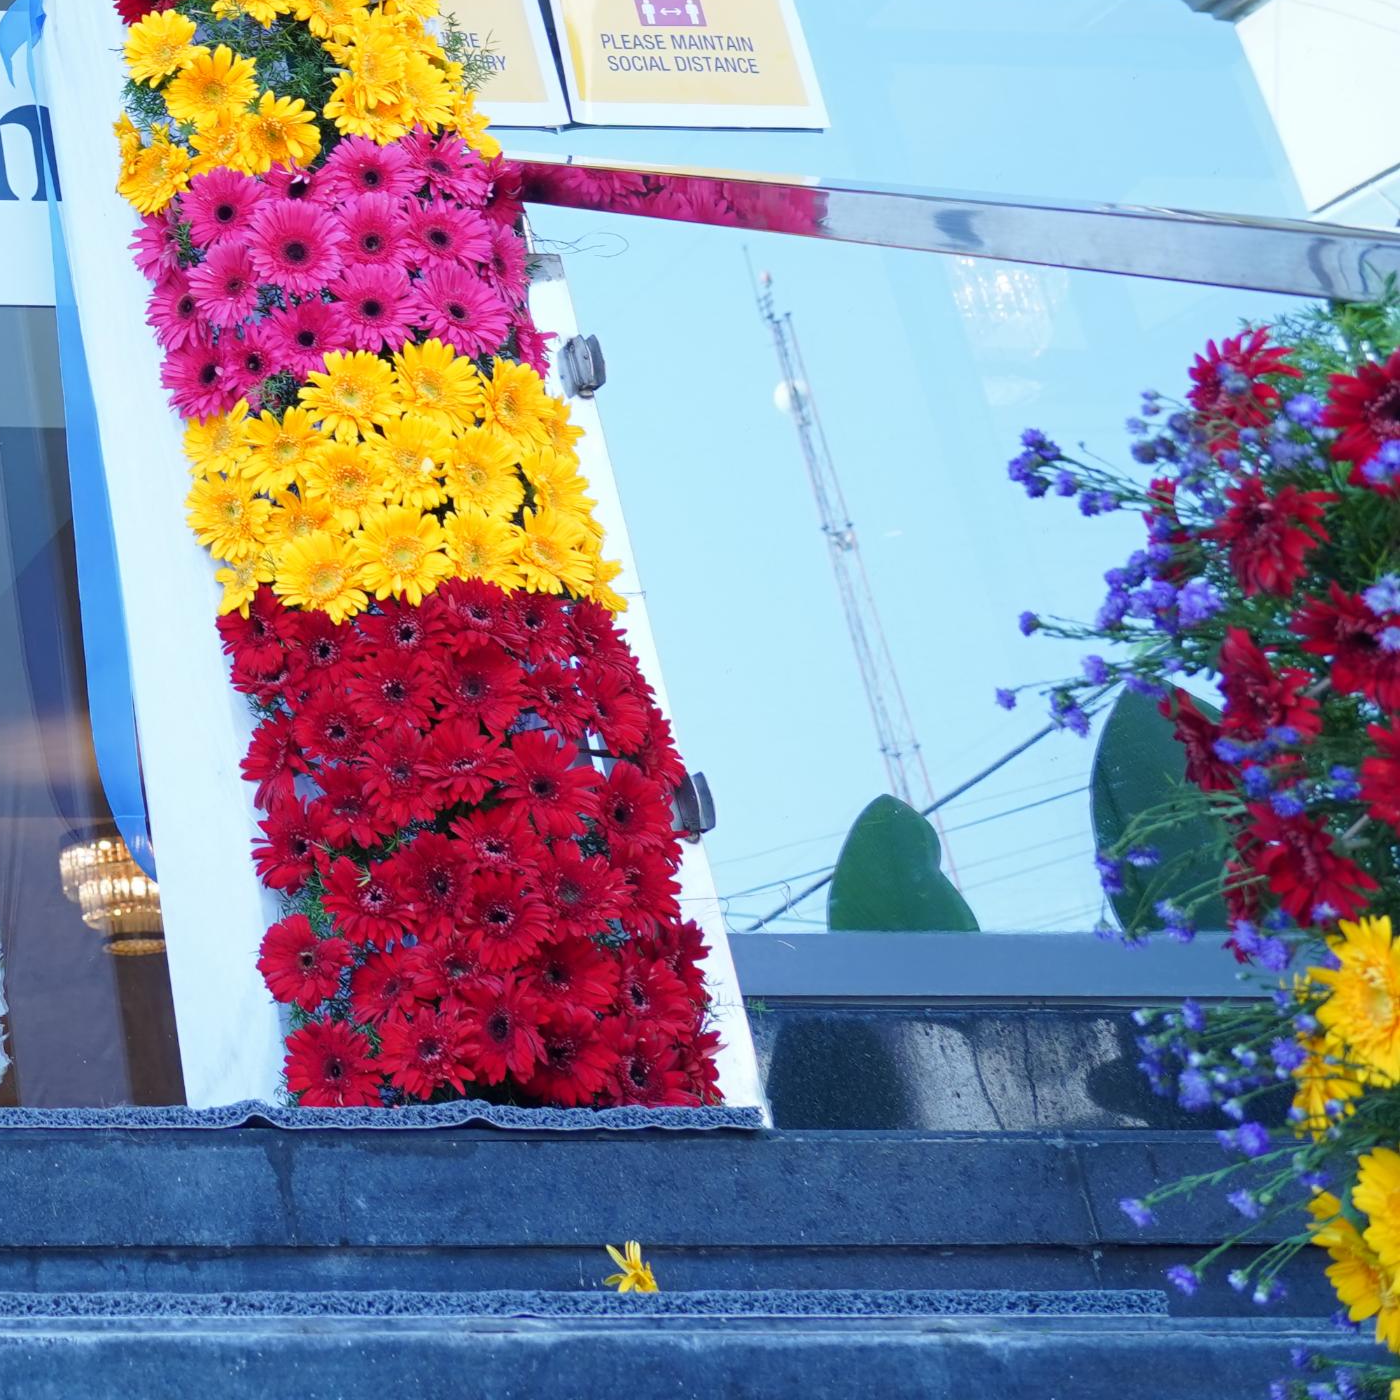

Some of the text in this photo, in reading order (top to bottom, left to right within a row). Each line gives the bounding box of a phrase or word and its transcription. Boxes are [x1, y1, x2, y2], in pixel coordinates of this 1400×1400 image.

[600, 32, 754, 52] PLEASE MAINTAIN
[607, 55, 760, 74] SOCIAL DISTANCE
